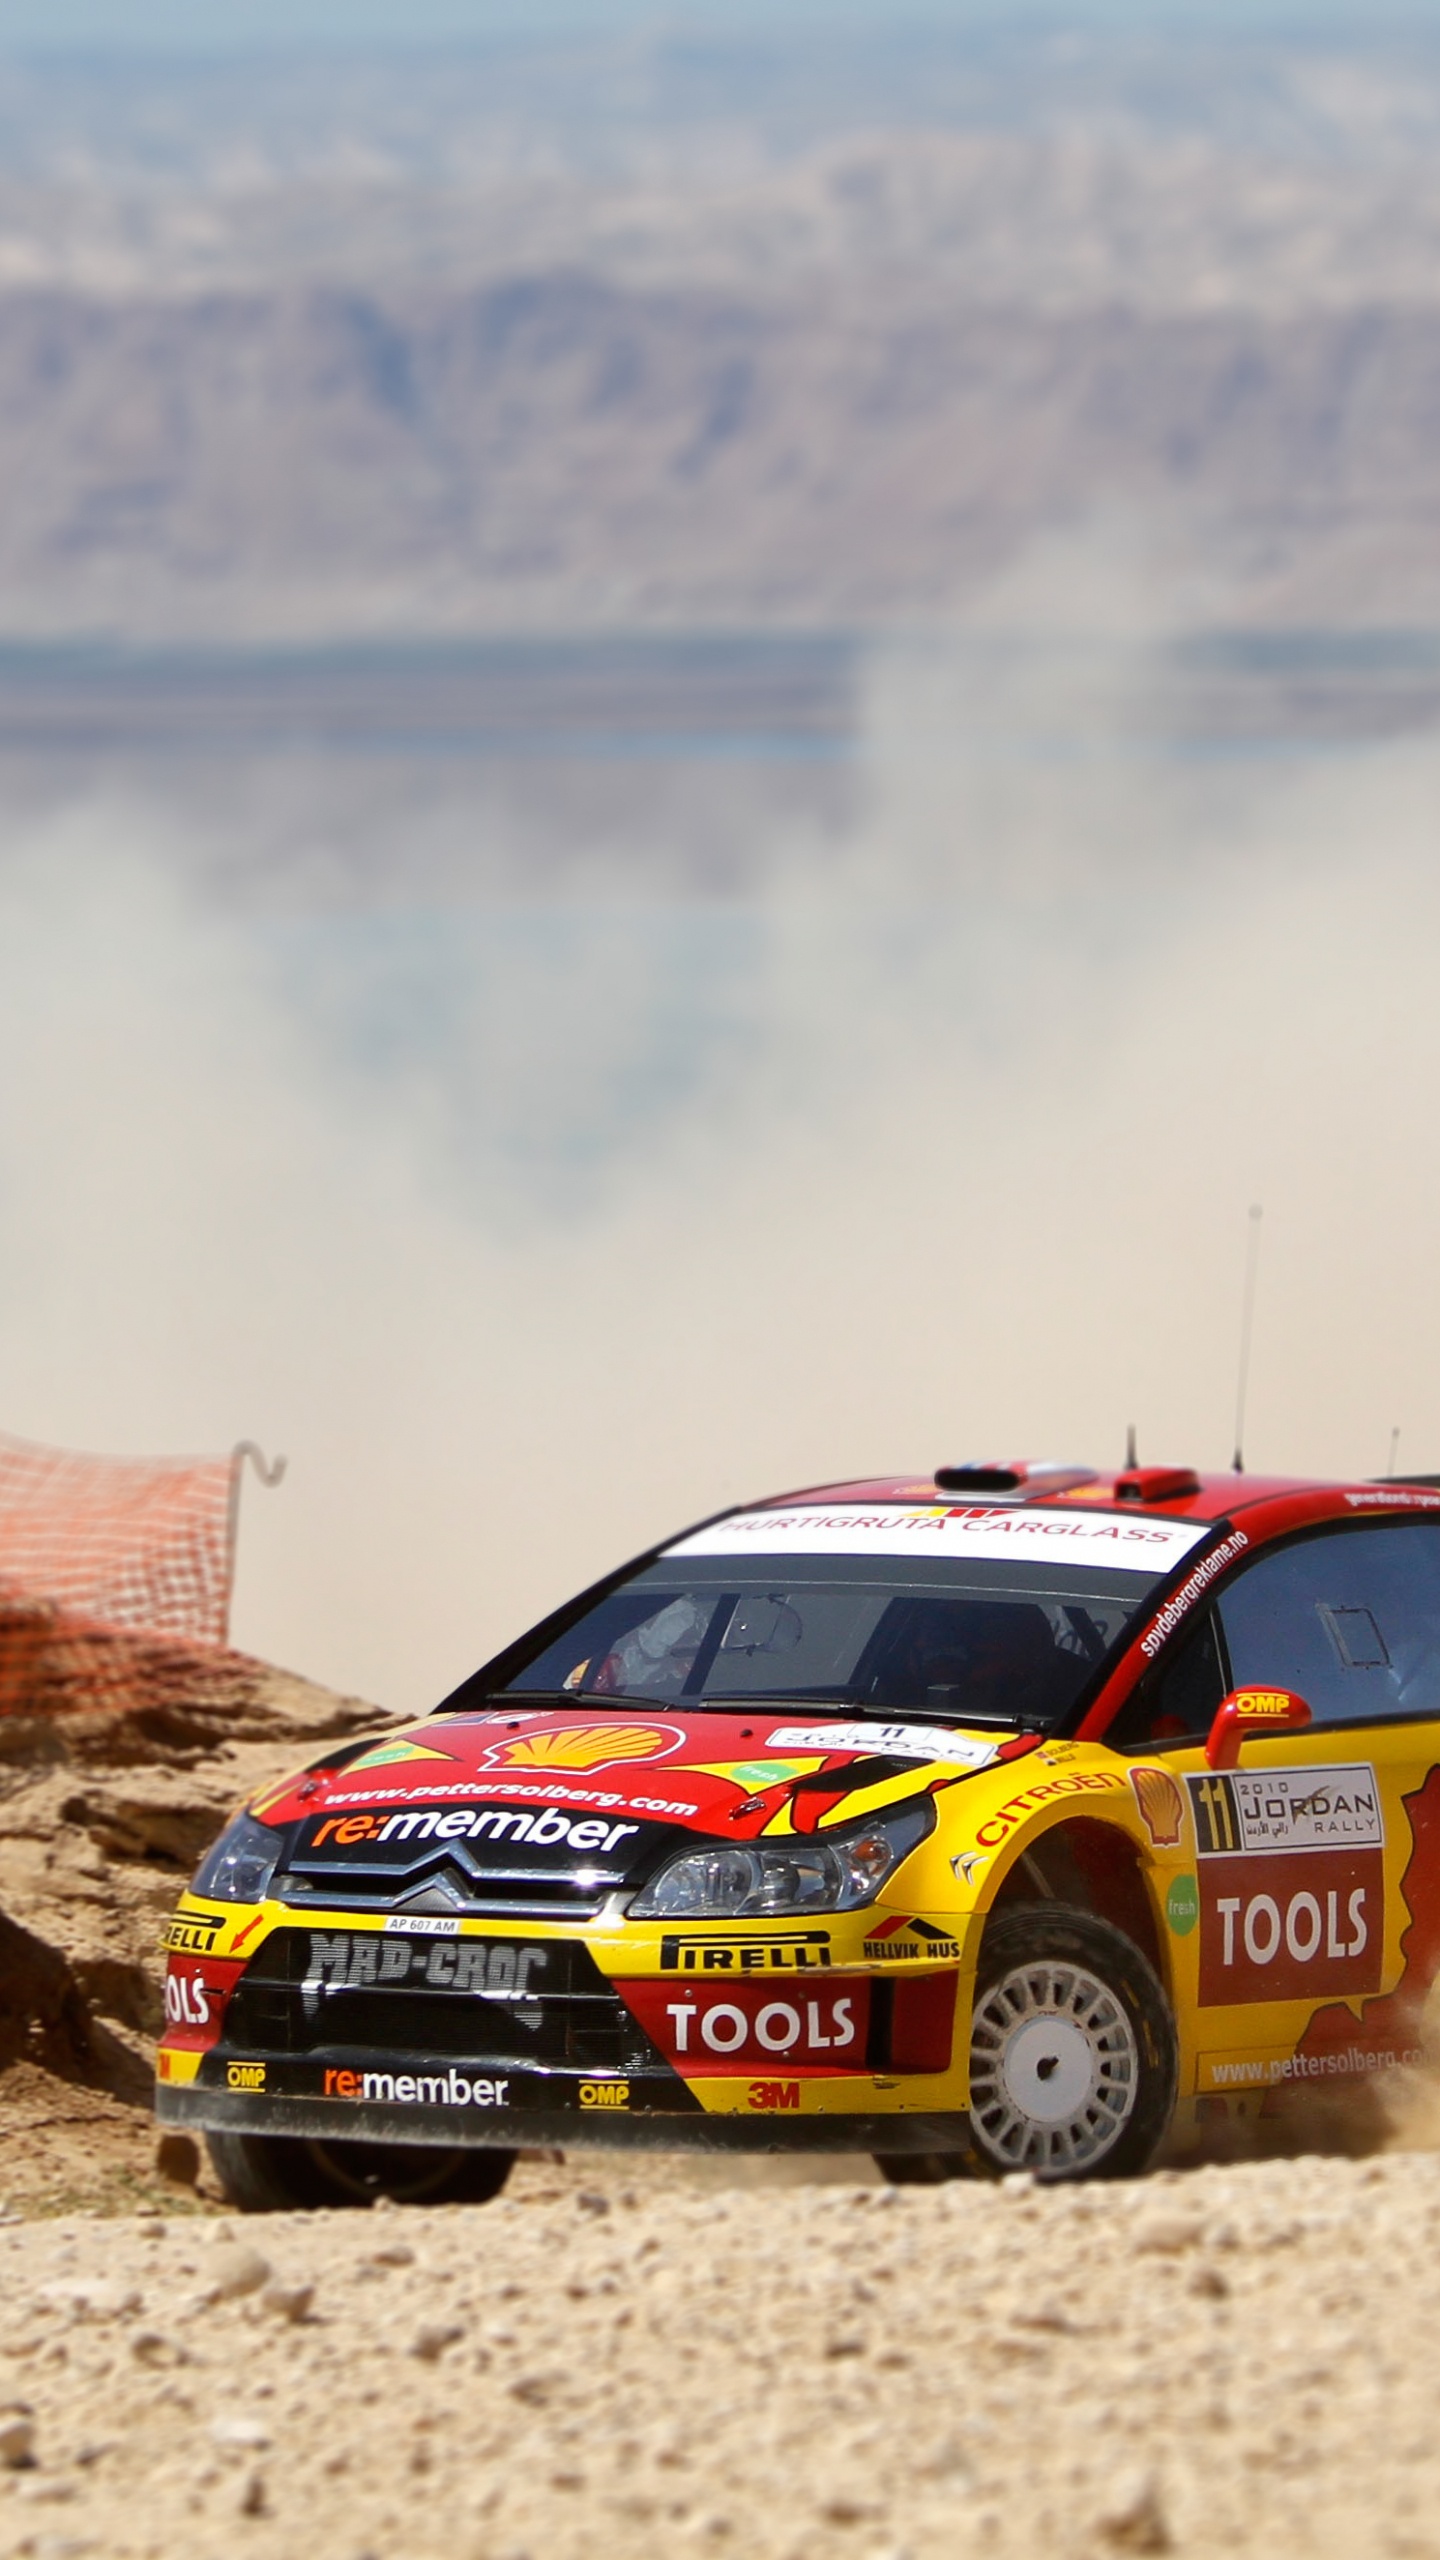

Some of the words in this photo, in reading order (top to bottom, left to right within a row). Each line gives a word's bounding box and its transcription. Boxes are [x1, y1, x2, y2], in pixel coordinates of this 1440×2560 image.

[719, 1516, 946, 1532] HURTIGRUTA
[961, 1519, 1174, 1543] CARGLASS
[1236, 1696, 1289, 1713] OMP
[879, 1726, 908, 1739] 11
[325, 1782, 698, 1818] www.pettersolberg.com
[1240, 1781, 1289, 1796] 2010
[1197, 1777, 1234, 1851] 11
[1243, 1793, 1375, 1822] JORDAN
[311, 1807, 640, 1854] re:member
[1314, 1818, 1376, 1833] RALLY
[1168, 1899, 1196, 1916] fresh
[389, 1918, 407, 1930] AP
[409, 1919, 431, 1931] 607
[433, 1920, 456, 1933] AM
[1216, 1887, 1368, 1966] TOOLS
[660, 1930, 831, 1970] PIRELLI
[863, 1941, 919, 1959] HELLVIK
[927, 1941, 960, 1958] HUS
[666, 1998, 855, 2053] TOOLS
[227, 2066, 266, 2088] OMP
[1211, 2047, 1426, 2084] www.pettersolberg.co
[323, 2068, 509, 2106] re:member
[579, 2084, 630, 2106] OMP
[747, 2081, 801, 2110] 3M
